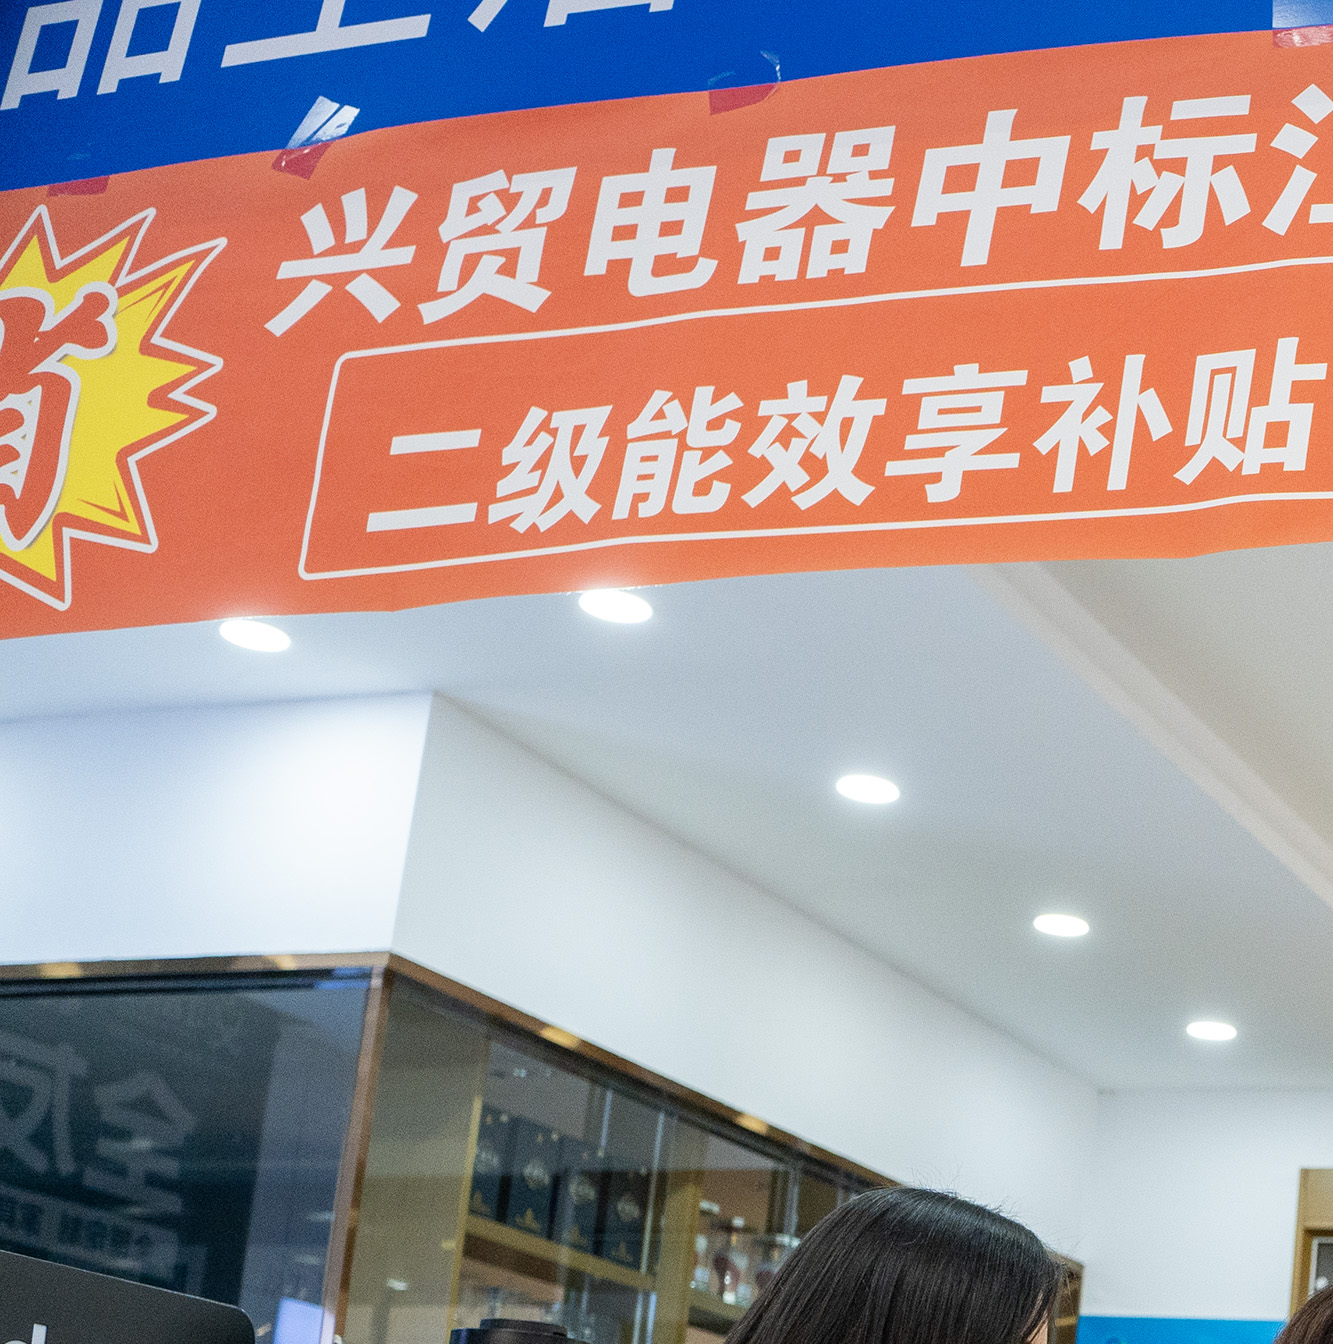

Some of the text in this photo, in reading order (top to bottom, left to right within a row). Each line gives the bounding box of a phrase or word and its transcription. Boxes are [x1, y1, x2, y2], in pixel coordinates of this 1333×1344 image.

[366, 337, 1328, 533] 二级能效享补贴
